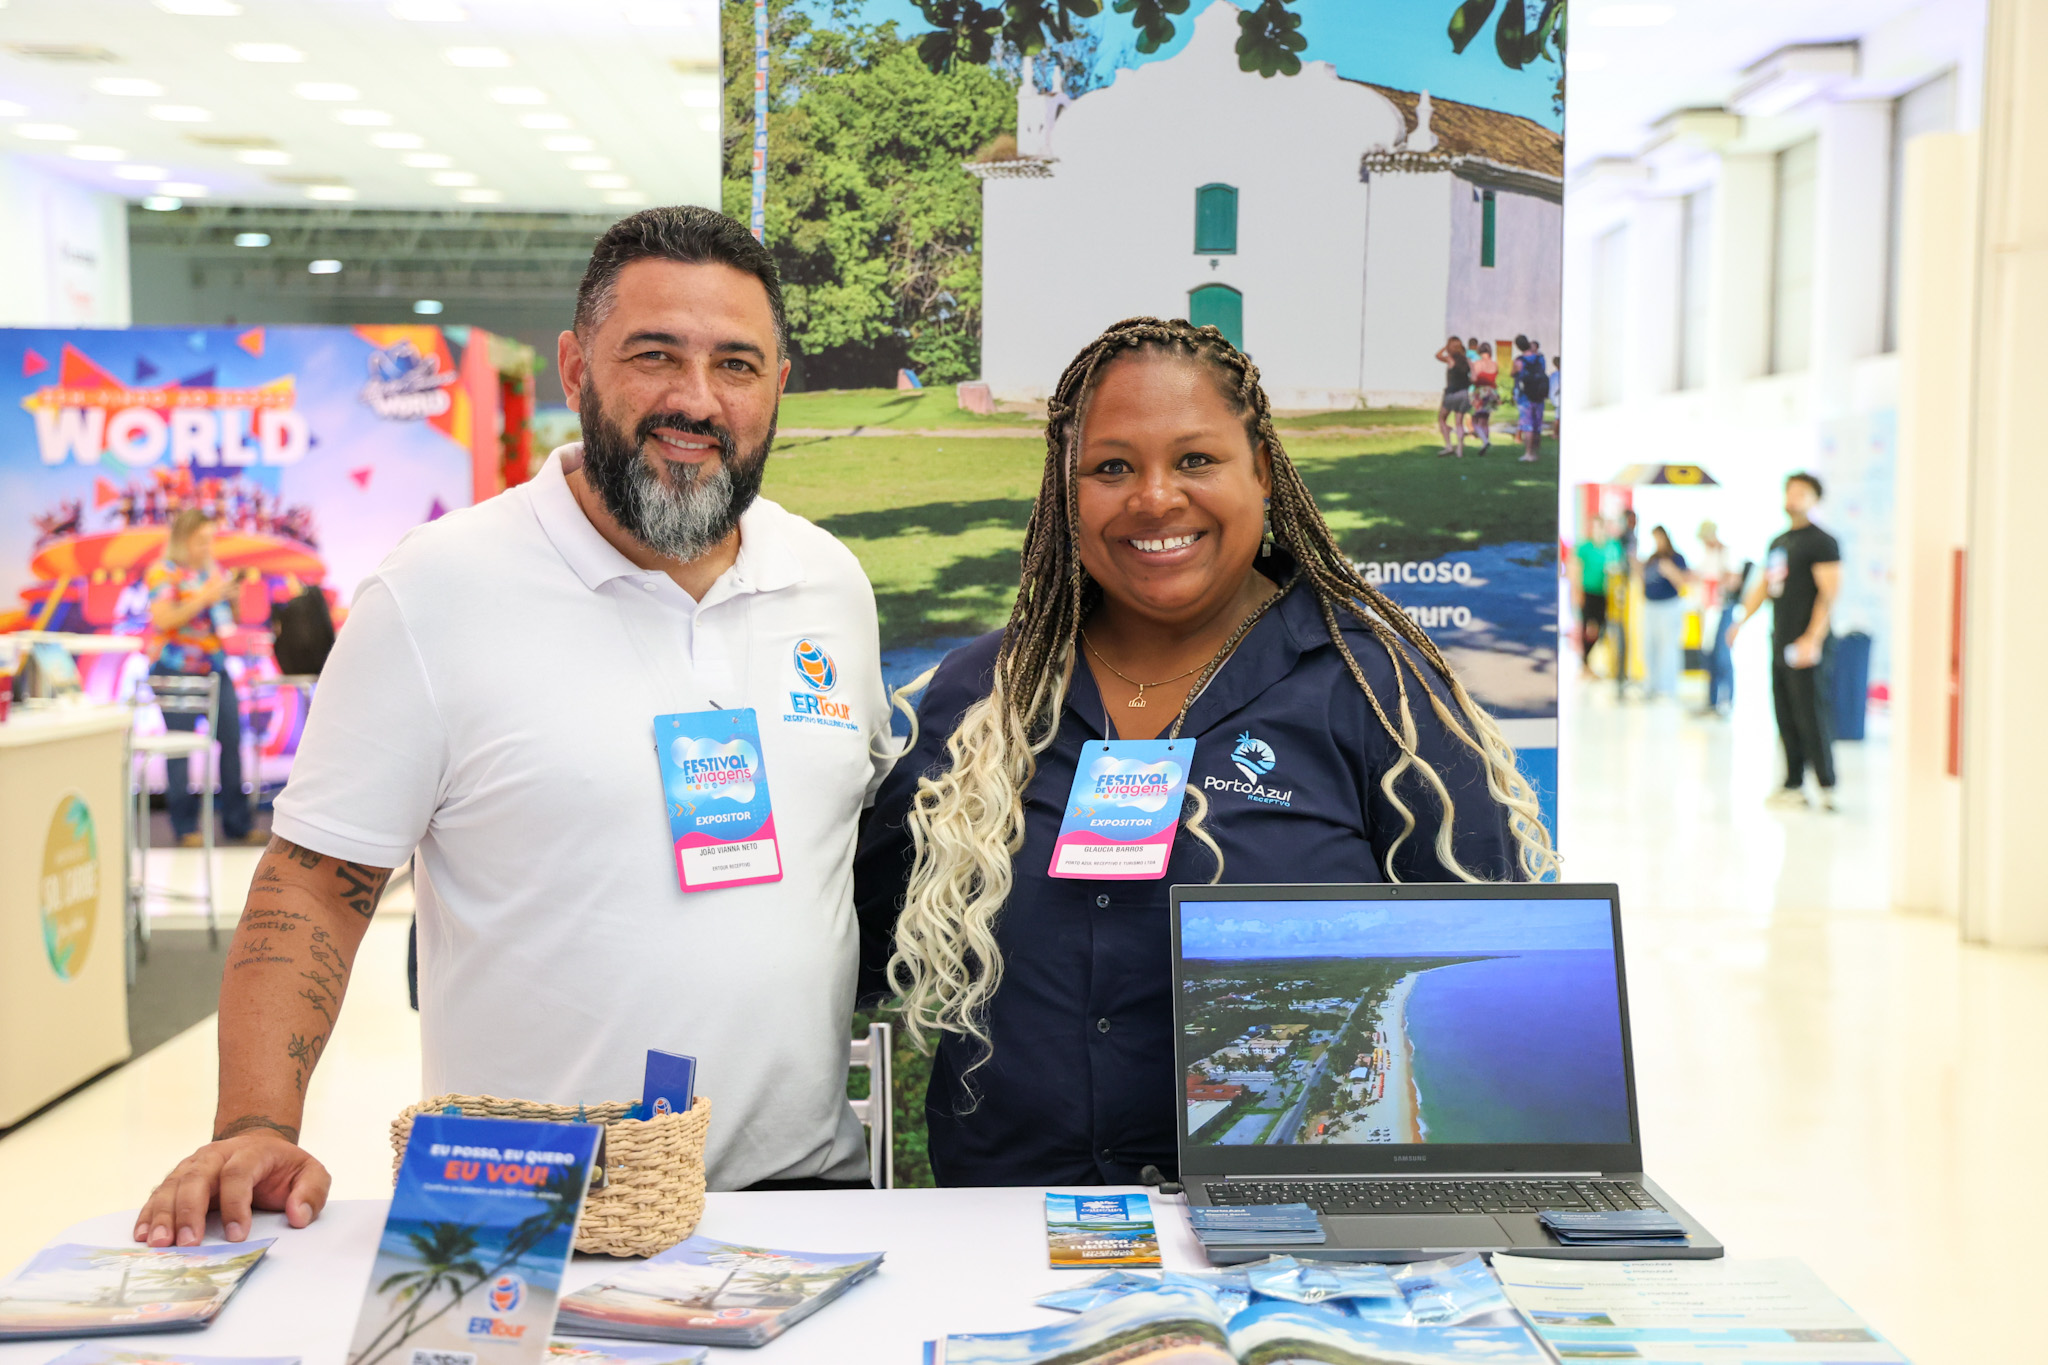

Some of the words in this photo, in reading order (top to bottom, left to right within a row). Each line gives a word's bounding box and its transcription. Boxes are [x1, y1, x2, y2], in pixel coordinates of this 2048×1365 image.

[35, 406, 309, 466] WORLD
[1345, 559, 1472, 584] rancoso
[790, 691, 850, 721] ERTour
[683, 754, 748, 776] FESTIVAL
[685, 776, 695, 784] DE
[1096, 773, 1168, 787] FESTIVAL
[695, 811, 751, 826] EXPOSITOR
[1089, 819, 1153, 827] EXPOSITOR
[699, 846, 716, 856] JOÃO
[717, 844, 741, 854] VIANNA
[742, 842, 758, 851] NETO
[246, 921, 296, 932] contigo
[443, 1160, 481, 1181] EU
[486, 1162, 549, 1187] VOU!
